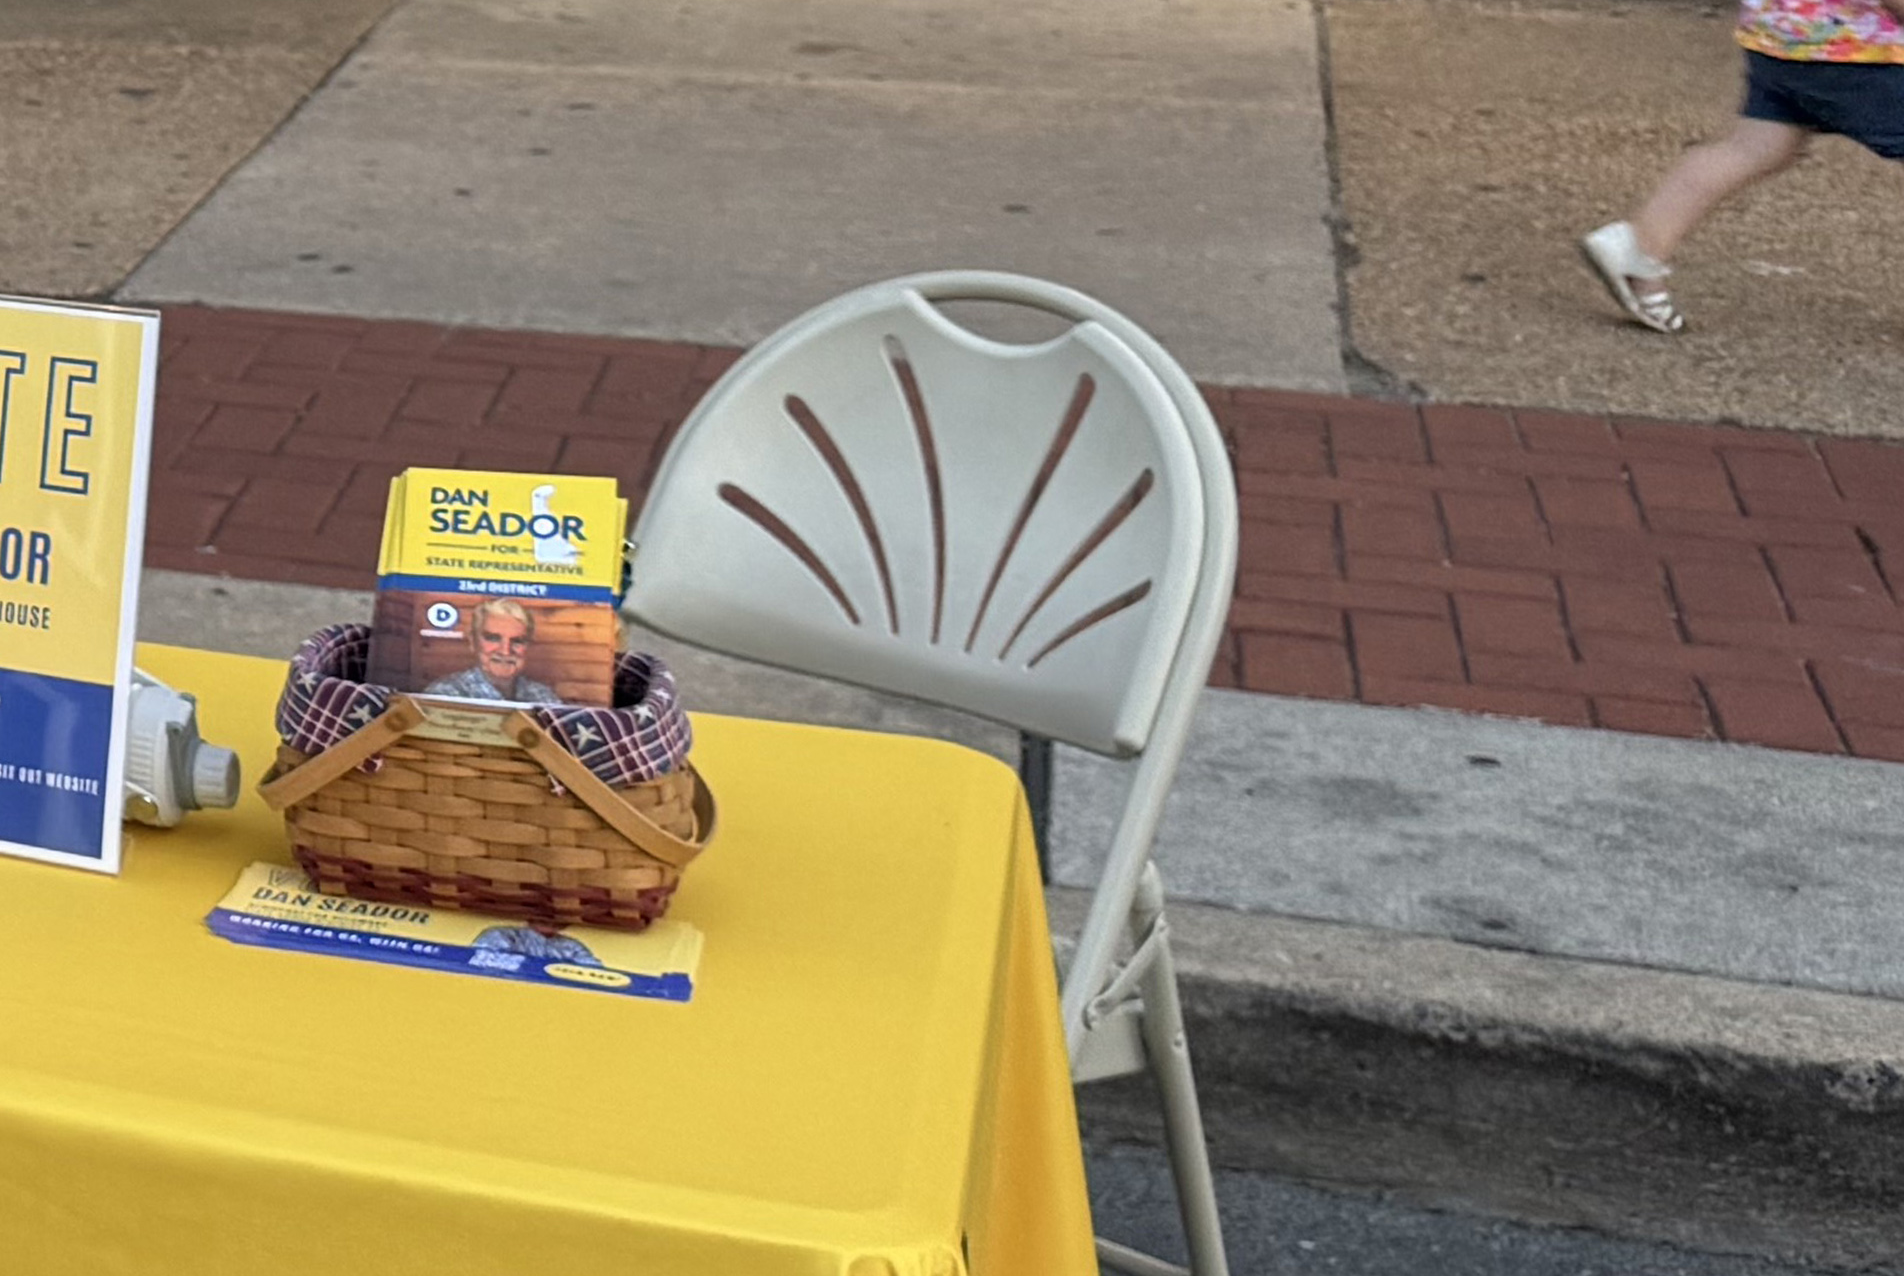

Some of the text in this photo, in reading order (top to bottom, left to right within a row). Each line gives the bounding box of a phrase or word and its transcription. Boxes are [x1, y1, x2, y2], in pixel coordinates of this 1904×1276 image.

[430, 486, 489, 508] DAN
[428, 508, 588, 542] SEADOR
[491, 543, 520, 554] FOR
[252, 886, 312, 908] DAN
[317, 897, 431, 925] SEADOR
